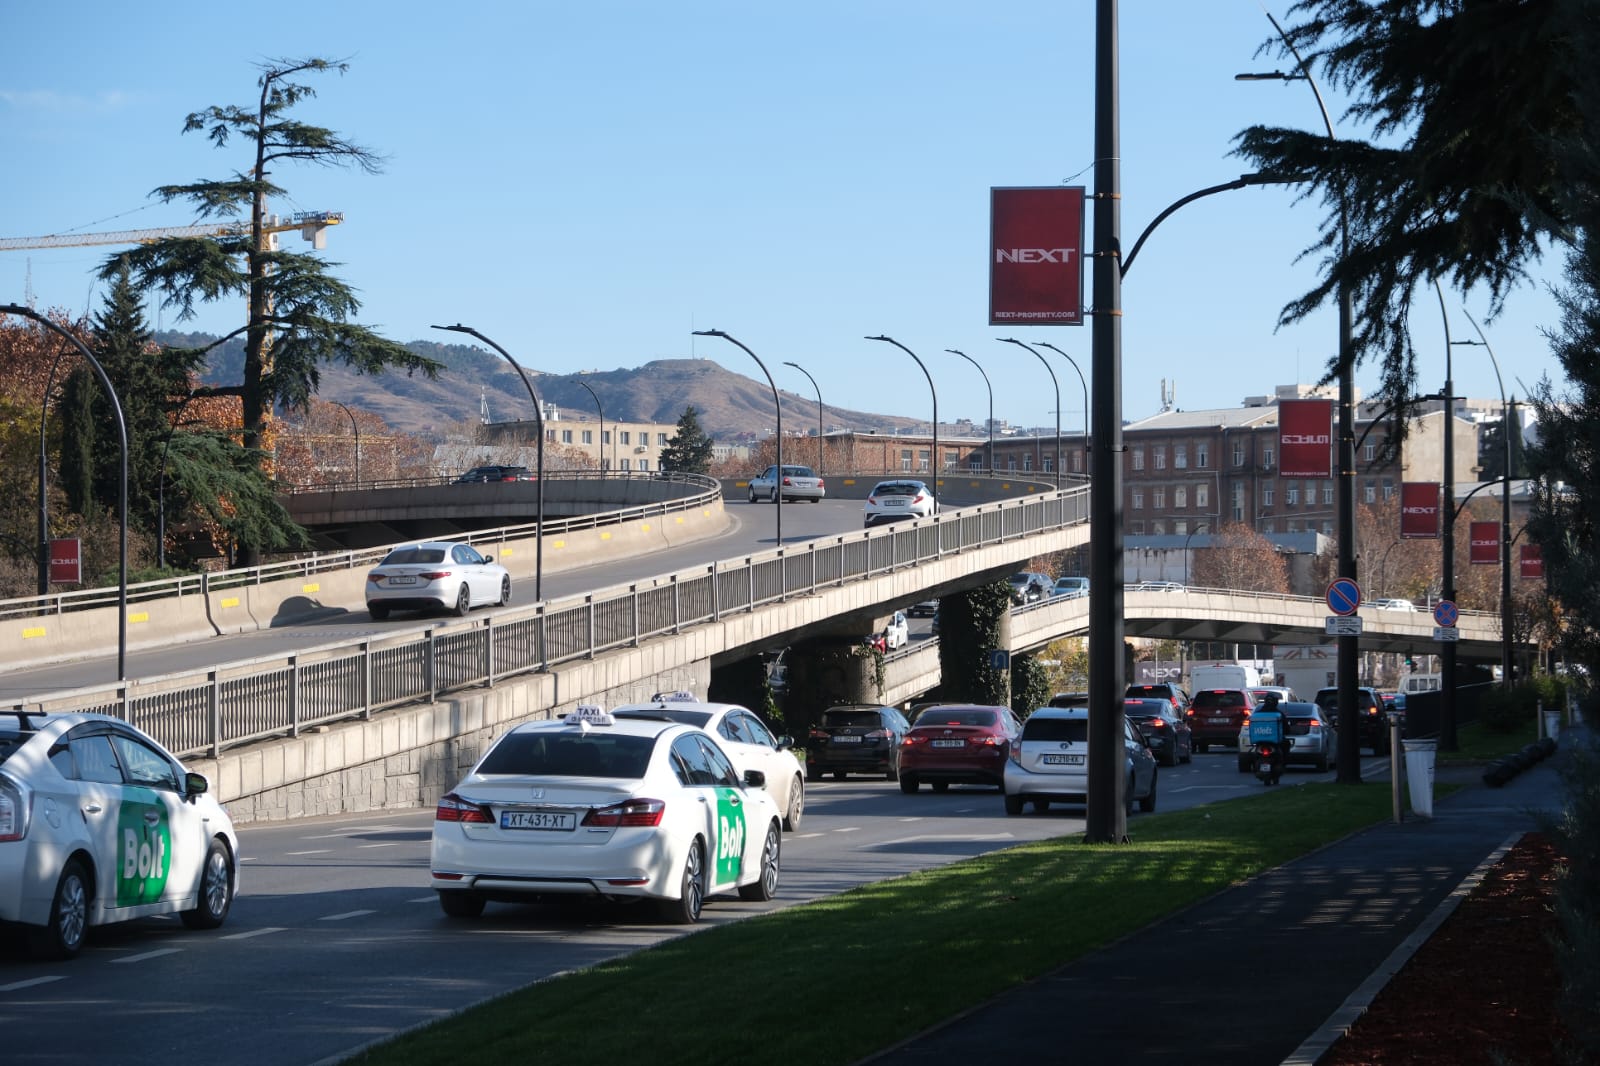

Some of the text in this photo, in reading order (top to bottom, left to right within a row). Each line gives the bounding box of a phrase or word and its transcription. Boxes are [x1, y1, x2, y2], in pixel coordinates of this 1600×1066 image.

[996, 248, 1075, 263] NEXT
[577, 708, 600, 716] TAXI
[1254, 727, 1272, 735] Wolt
[510, 814, 567, 827] XT-431-XT
[719, 815, 743, 860] Bolt
[123, 828, 165, 879] Bolt
